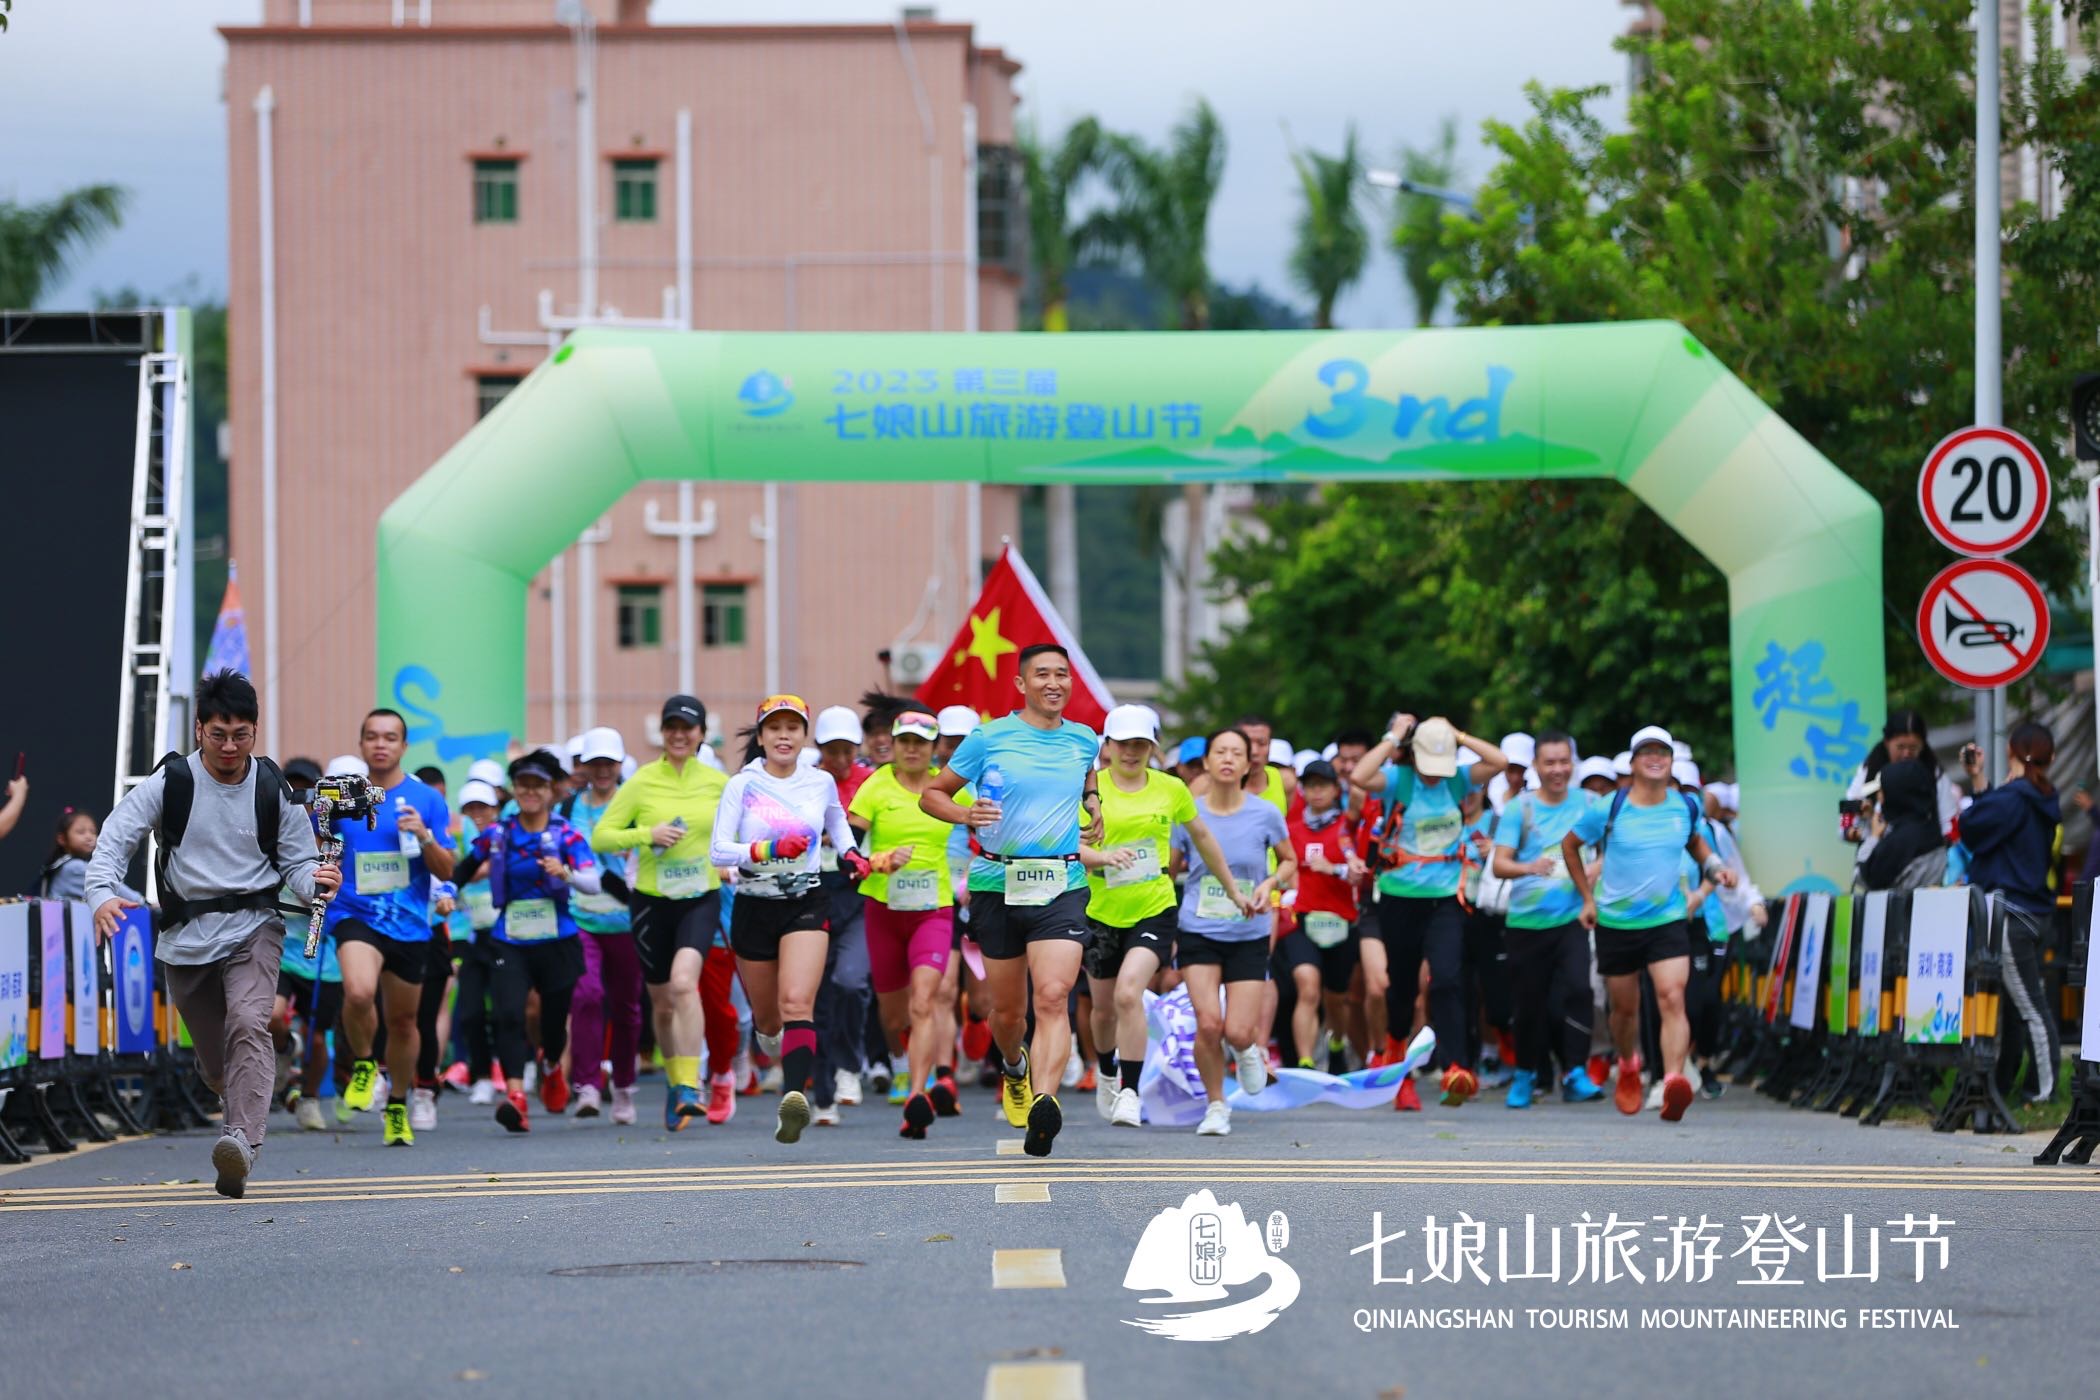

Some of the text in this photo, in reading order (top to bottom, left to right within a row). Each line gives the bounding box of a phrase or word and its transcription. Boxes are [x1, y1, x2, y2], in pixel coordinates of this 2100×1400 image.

[831, 367, 1058, 396] 2023 第三届
[824, 402, 1202, 440] 七娘山旅游登山节
[1950, 457, 2022, 522] 20
[1017, 870, 1055, 881] 041A
